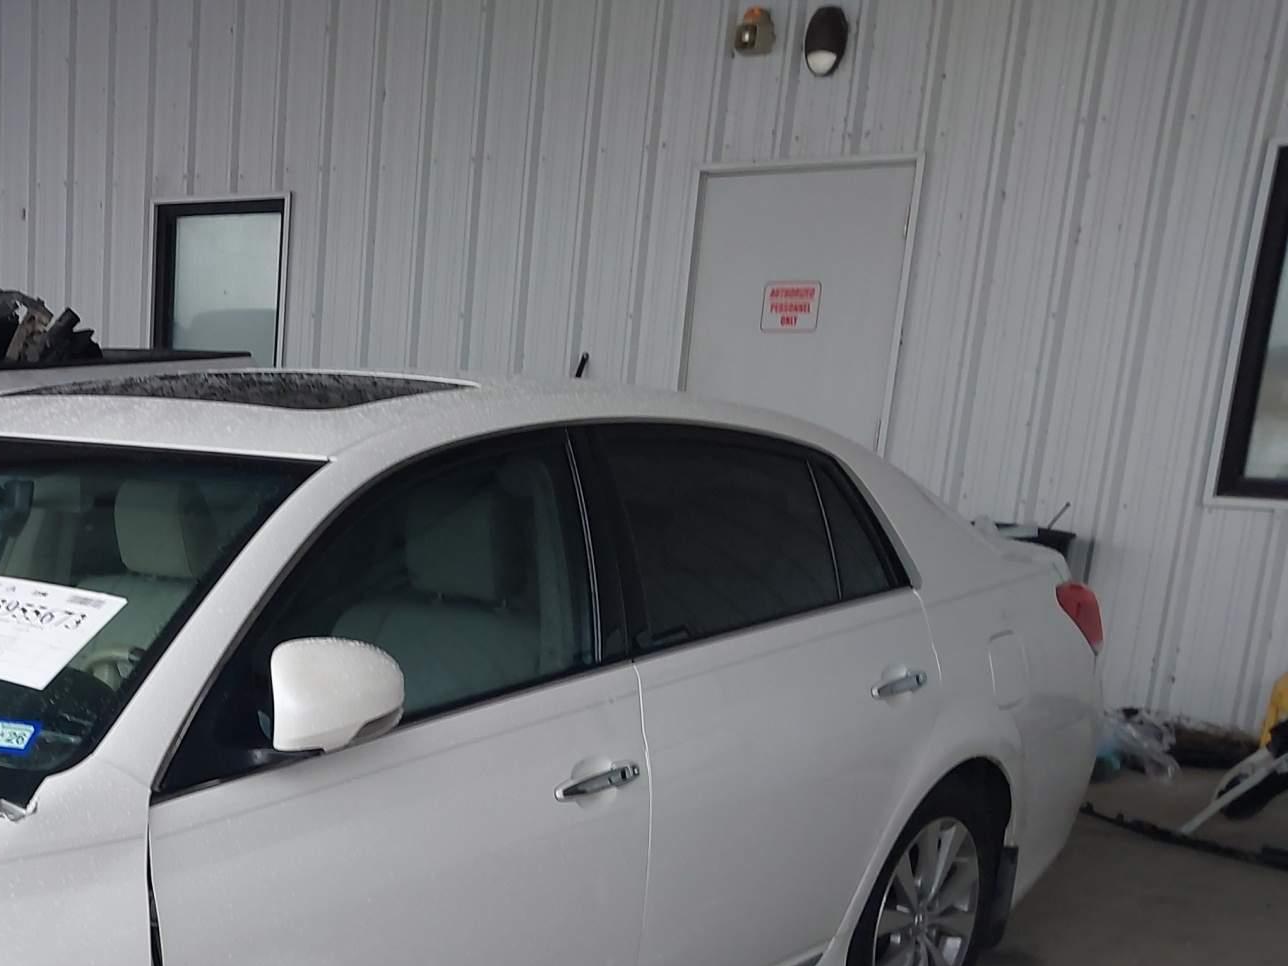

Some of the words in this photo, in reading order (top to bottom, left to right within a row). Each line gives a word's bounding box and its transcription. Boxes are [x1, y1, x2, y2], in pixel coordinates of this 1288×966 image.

[769, 287, 816, 298] AUTHORIZED
[770, 303, 811, 314] PERSONNEL
[780, 315, 799, 327] ONLY
